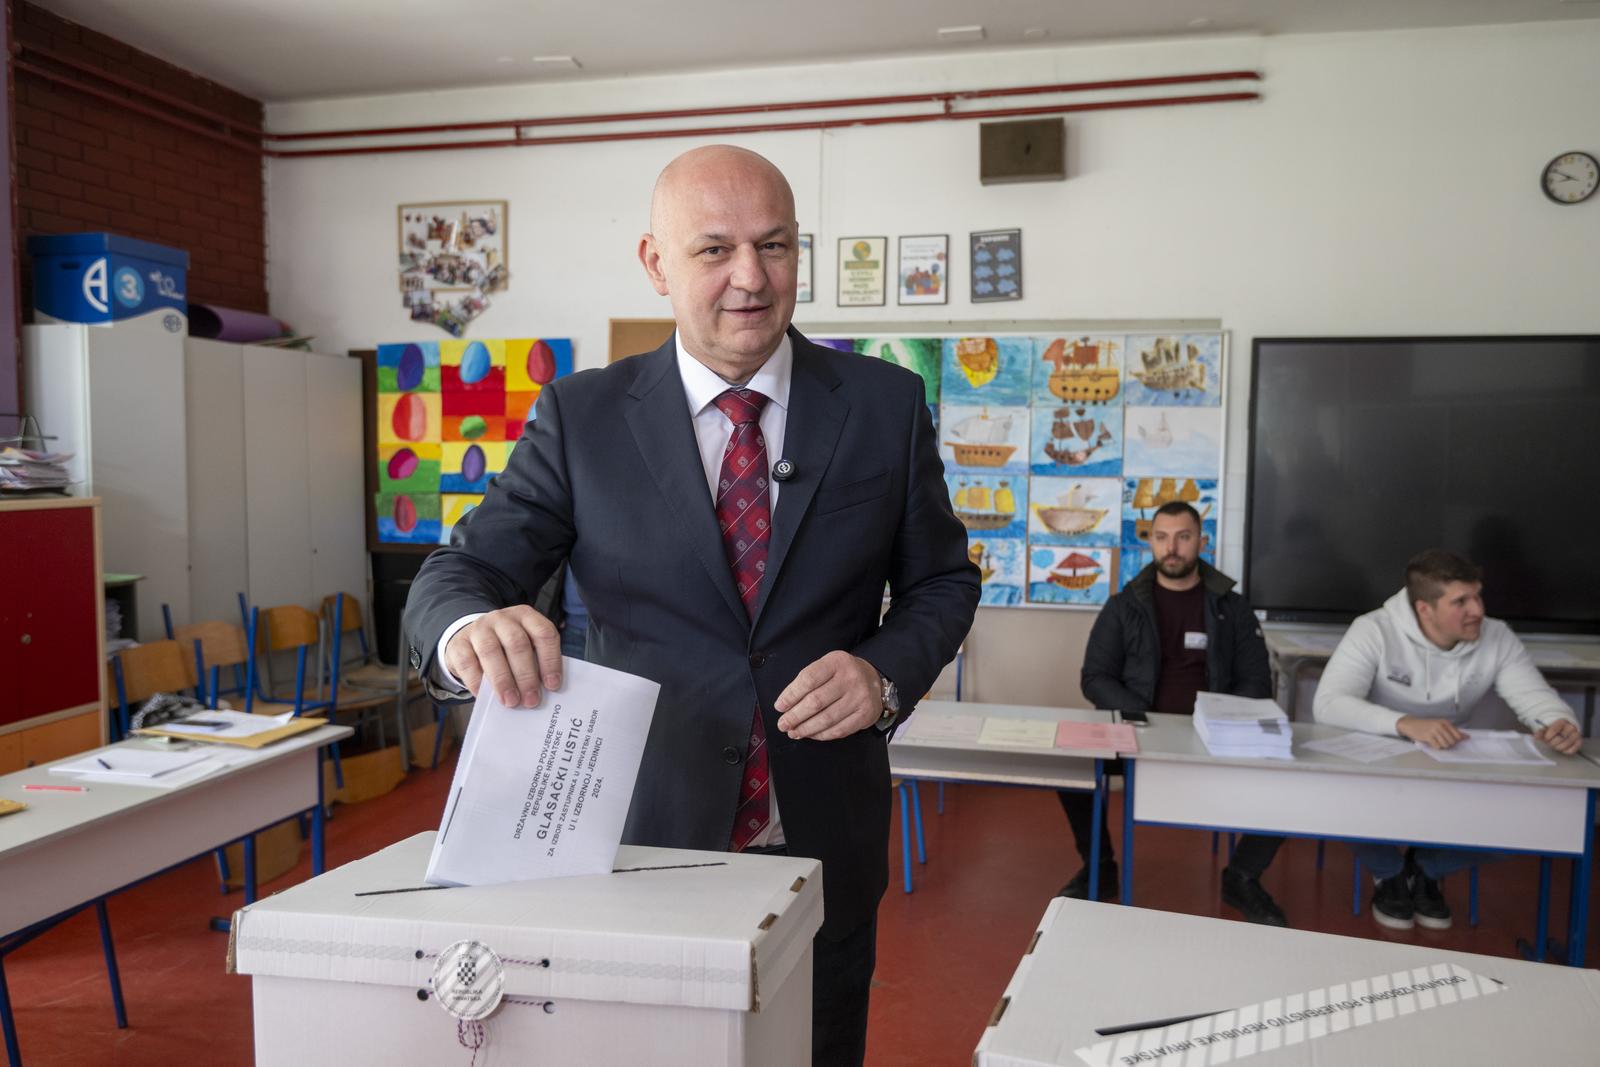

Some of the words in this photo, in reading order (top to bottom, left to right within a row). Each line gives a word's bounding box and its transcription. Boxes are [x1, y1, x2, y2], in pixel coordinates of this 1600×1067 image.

[513, 801, 532, 839] DRŽAVNO
[528, 765, 544, 801] IZBORNO
[540, 703, 562, 765] POVJERENSTVO
[530, 772, 551, 817] REPUBLIKE
[546, 730, 563, 771] HRVATSKE
[536, 766, 569, 840] GLASAČKI
[562, 718, 583, 763] LISTIĆ
[547, 846, 555, 857] ZA
[551, 823, 563, 846] IZBOR
[560, 778, 578, 823] ZASTUPNIKA
[576, 734, 591, 770] HRVATSKI
[588, 709, 599, 735] SABOR
[568, 823, 576, 831] U
[573, 774, 592, 817] IZBORNOJ
[587, 737, 604, 773] JEDINICI
[591, 776, 605, 799] 2024.
[1267, 999, 1362, 1028] POVJERENSTVO
[1360, 986, 1413, 1004] IZBORNO
[1120, 1039, 1199, 1067] HRVATSKE
[1197, 1023, 1269, 1047] REPUBLIKE
